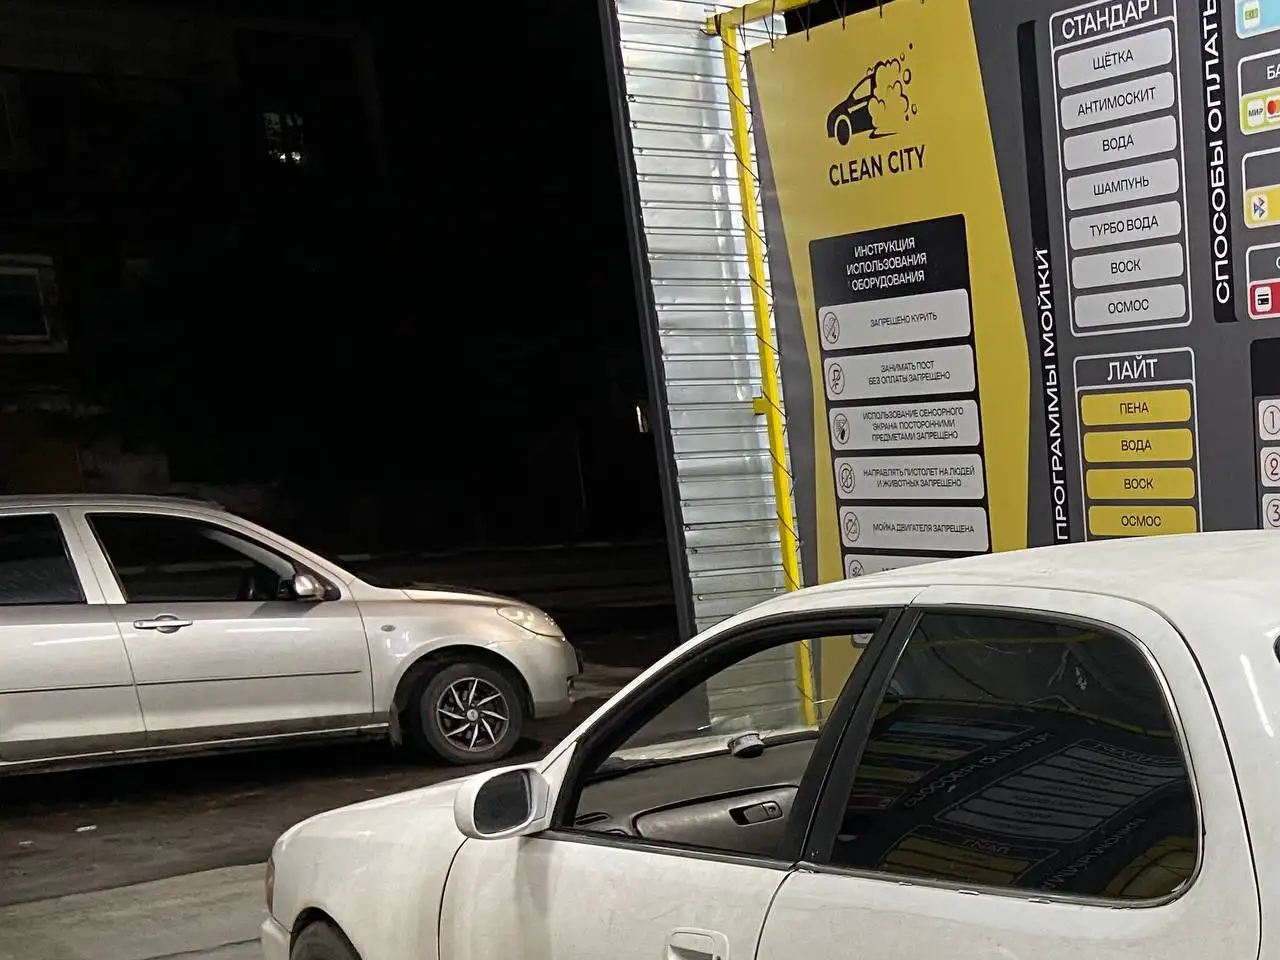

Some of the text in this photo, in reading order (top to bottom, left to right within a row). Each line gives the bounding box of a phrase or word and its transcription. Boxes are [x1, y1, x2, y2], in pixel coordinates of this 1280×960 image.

[1092, 49, 1134, 70] ЩЁТКА
[1077, 87, 1156, 117] АНТИМОСКИТ
[1248, 108, 1264, 118] МИР
[1102, 133, 1134, 152] ВОДА
[829, 145, 926, 187] CLEAN CITY
[1093, 176, 1150, 196] ШАМПУНЬ
[1090, 215, 1159, 237] ТУРБО ВОДА
[1210, 140, 1230, 304] СПОСОБЫ
[854, 237, 916, 258] ИНСТРУКЦИЯ
[846, 252, 927, 275] ИСПОЛЬЗОВАНИЯ
[1110, 259, 1142, 274] ВОСК
[851, 270, 925, 291] ОБОРУДОВАНИЯ
[1108, 298, 1150, 314] ОСМОС
[870, 312, 937, 327] ЗАПРЕЩЕНО КУРИТЬ
[1107, 354, 1158, 381] ЛАЙТ
[868, 377, 880, 385] БЕЗ
[908, 371, 950, 382] ЗАПРЕЩЕНО
[1035, 249, 1070, 540] ПРОГРАММЫ МОЙКИ
[1119, 401, 1149, 414] ПЕНА
[1269, 411, 1275, 429] 1
[1121, 439, 1152, 452] ВОДА
[939, 467, 948, 475] НА
[1270, 457, 1279, 476] 2
[920, 479, 961, 487] ЗАПРЕЩЕНО
[1124, 478, 1154, 490] ВОСК
[1121, 515, 1162, 527] ОСМОС
[1272, 504, 1280, 522] 3
[873, 522, 974, 533] МОЙКА ДВИГАТЕЛЯ ЗАПРЕЩЕНА
